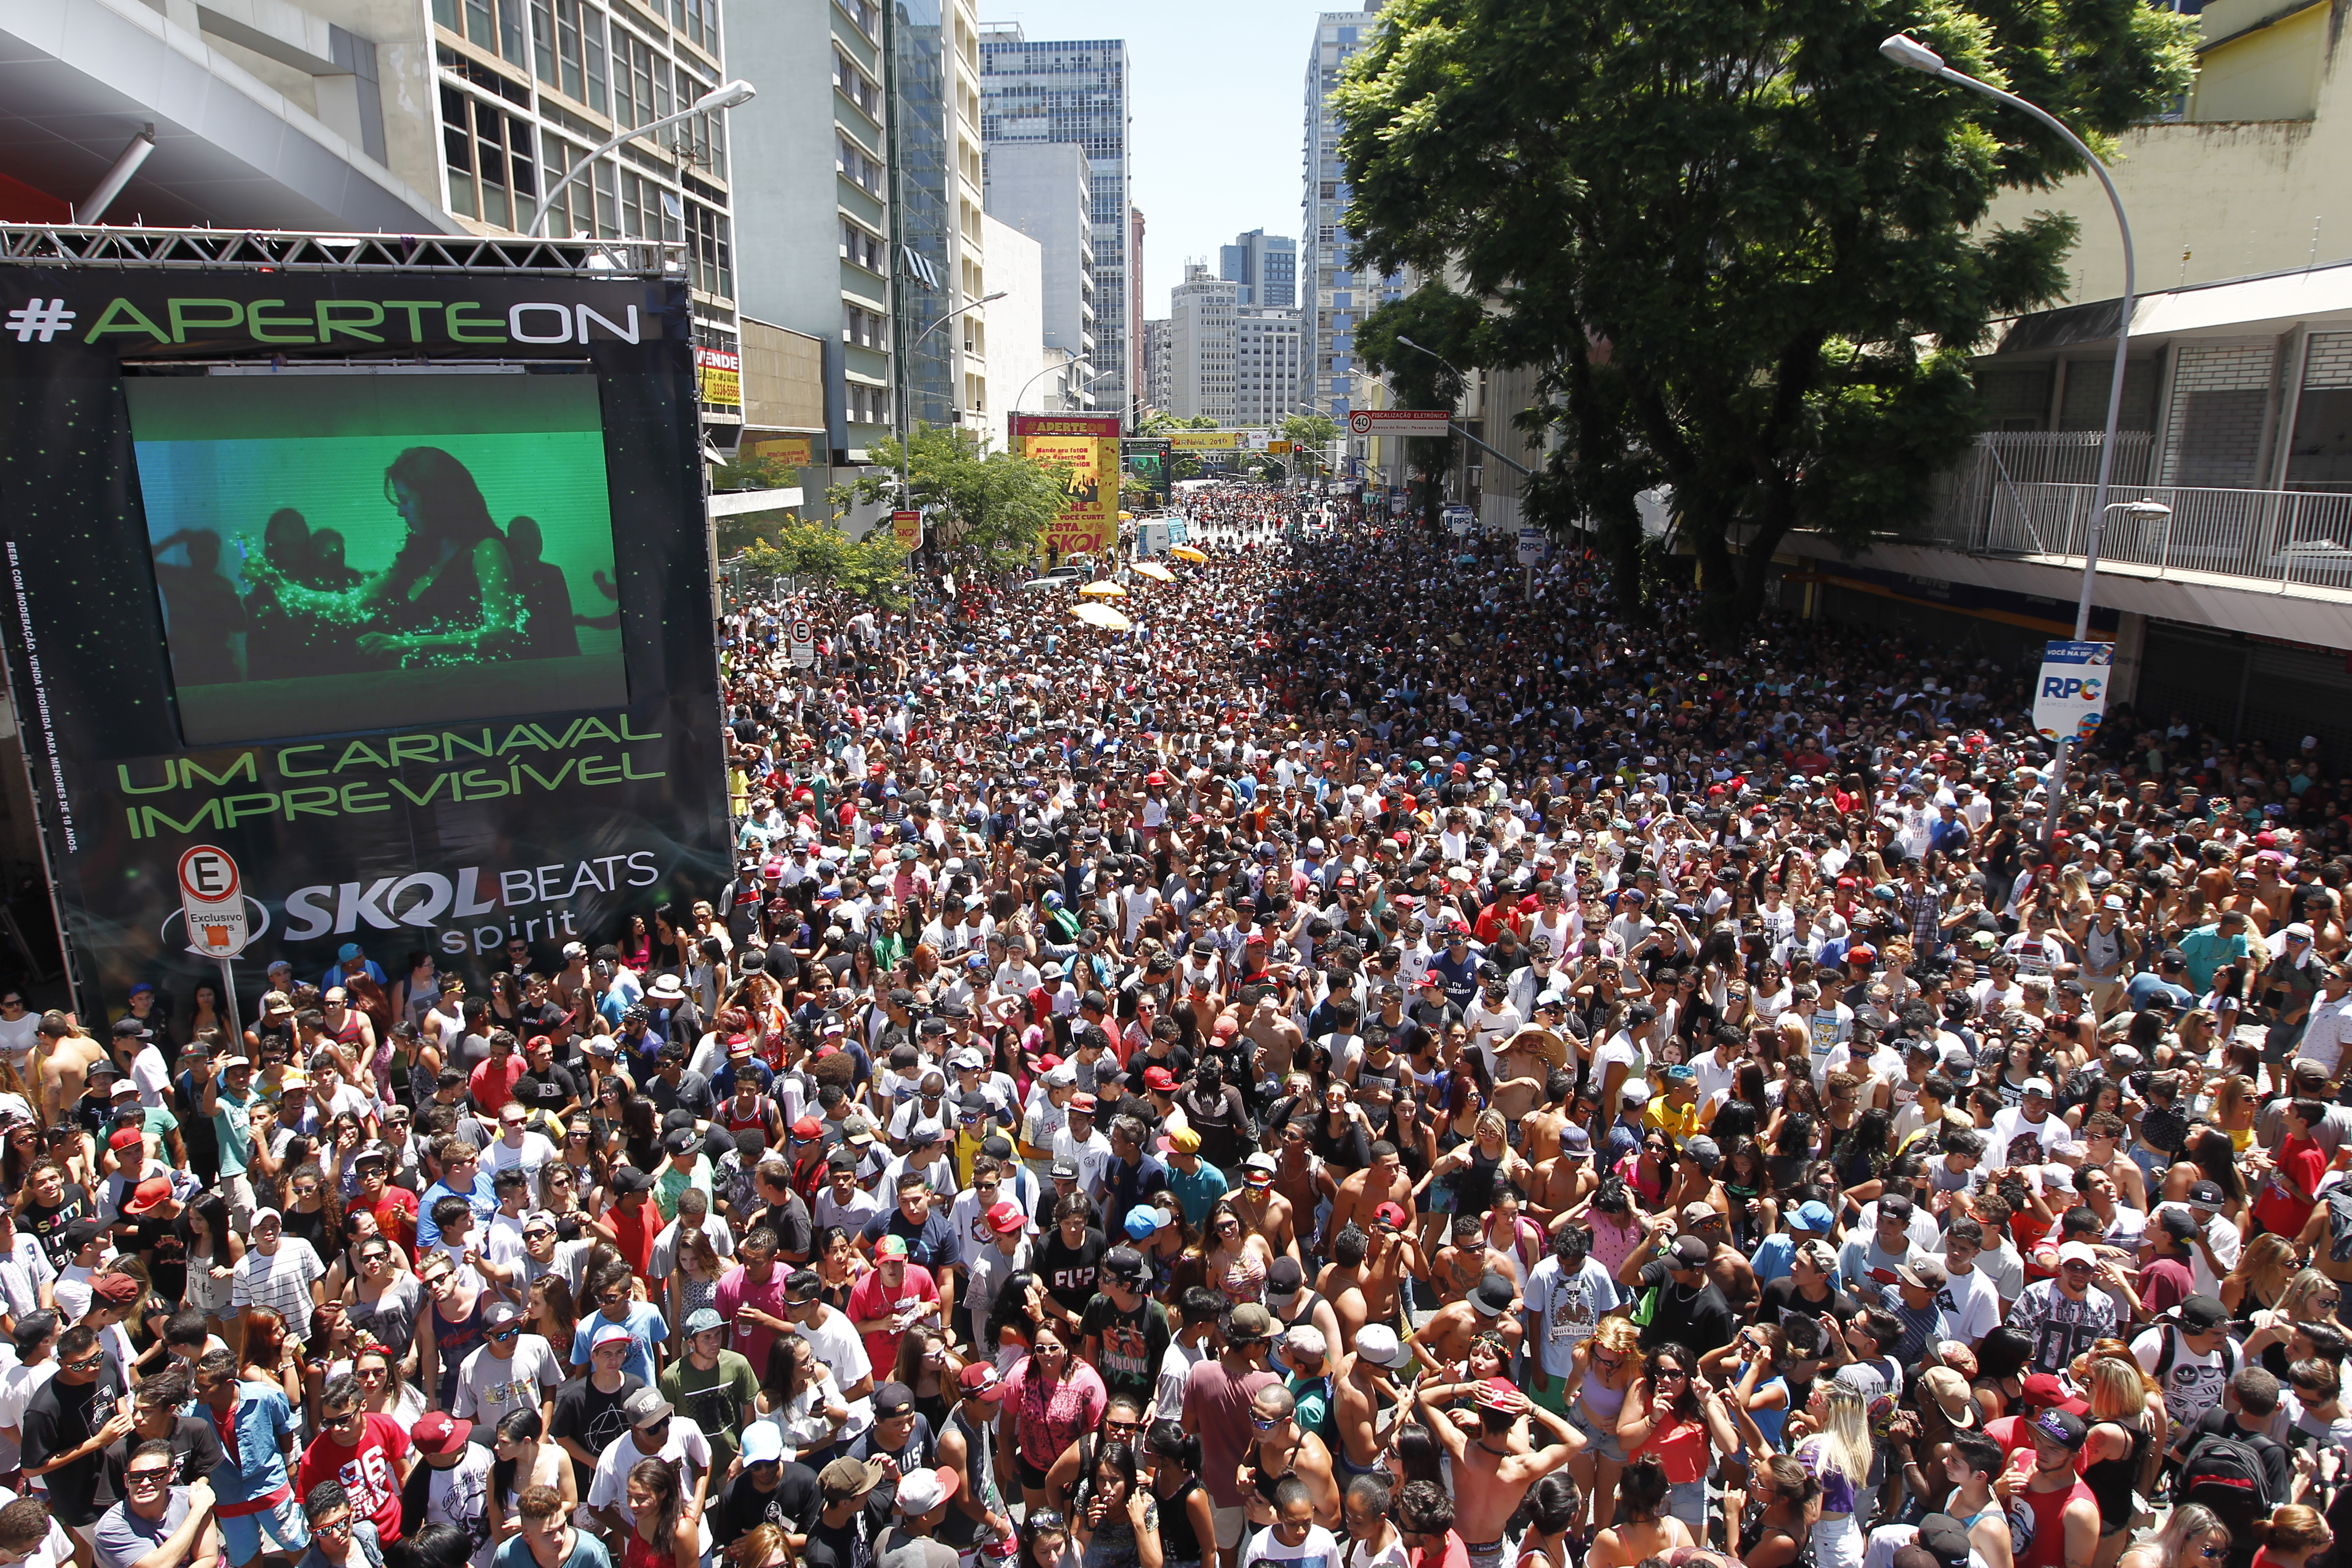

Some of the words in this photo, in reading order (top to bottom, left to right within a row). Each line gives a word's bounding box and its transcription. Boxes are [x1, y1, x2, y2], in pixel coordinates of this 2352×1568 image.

[5, 298, 640, 344] #APERTEON
[697, 350, 738, 370] VENDE
[713, 383, 739, 397] 3336-5566
[1025, 421, 1106, 432] #APERTEON
[1355, 417, 1368, 427] 40
[1210, 436, 1227, 445] 2016
[897, 528, 919, 537] SKOL
[1045, 534, 1104, 553] SKOL
[1520, 542, 1543, 552] RPC
[6, 541, 19, 567] BEBA
[12, 569, 24, 590] COM
[16, 592, 37, 653] MODERAÇÃO.
[796, 624, 807, 638] E
[29, 654, 43, 686] VENDA
[2042, 676, 2102, 701] RPC
[36, 687, 51, 730] PROÍBIDA
[45, 731, 57, 755] PARA
[118, 752, 257, 794] UM
[278, 713, 662, 778] CARNAVAL
[50, 757, 66, 799] MENORES
[126, 752, 666, 839] IMPREVISÍVEL
[60, 801, 70, 813] DE
[62, 815, 72, 825] 18
[64, 827, 77, 854] ANOS.
[194, 857, 223, 892] E
[284, 866, 498, 941] SKOL
[500, 850, 660, 907] BEATS
[190, 913, 242, 923] Exclusivo
[441, 909, 577, 955] spirit
[1752, 1004, 1769, 1014] OVE
[545, 1084, 553, 1095] 8
[1997, 1085, 2021, 1099] BROOK
[1044, 1121, 1057, 1134] 36
[37, 1200, 81, 1233] sorry
[1102, 1350, 1146, 1373] CHRONIC
[2171, 1383, 2182, 1392] 72
[637, 1393, 660, 1413] KINGS
